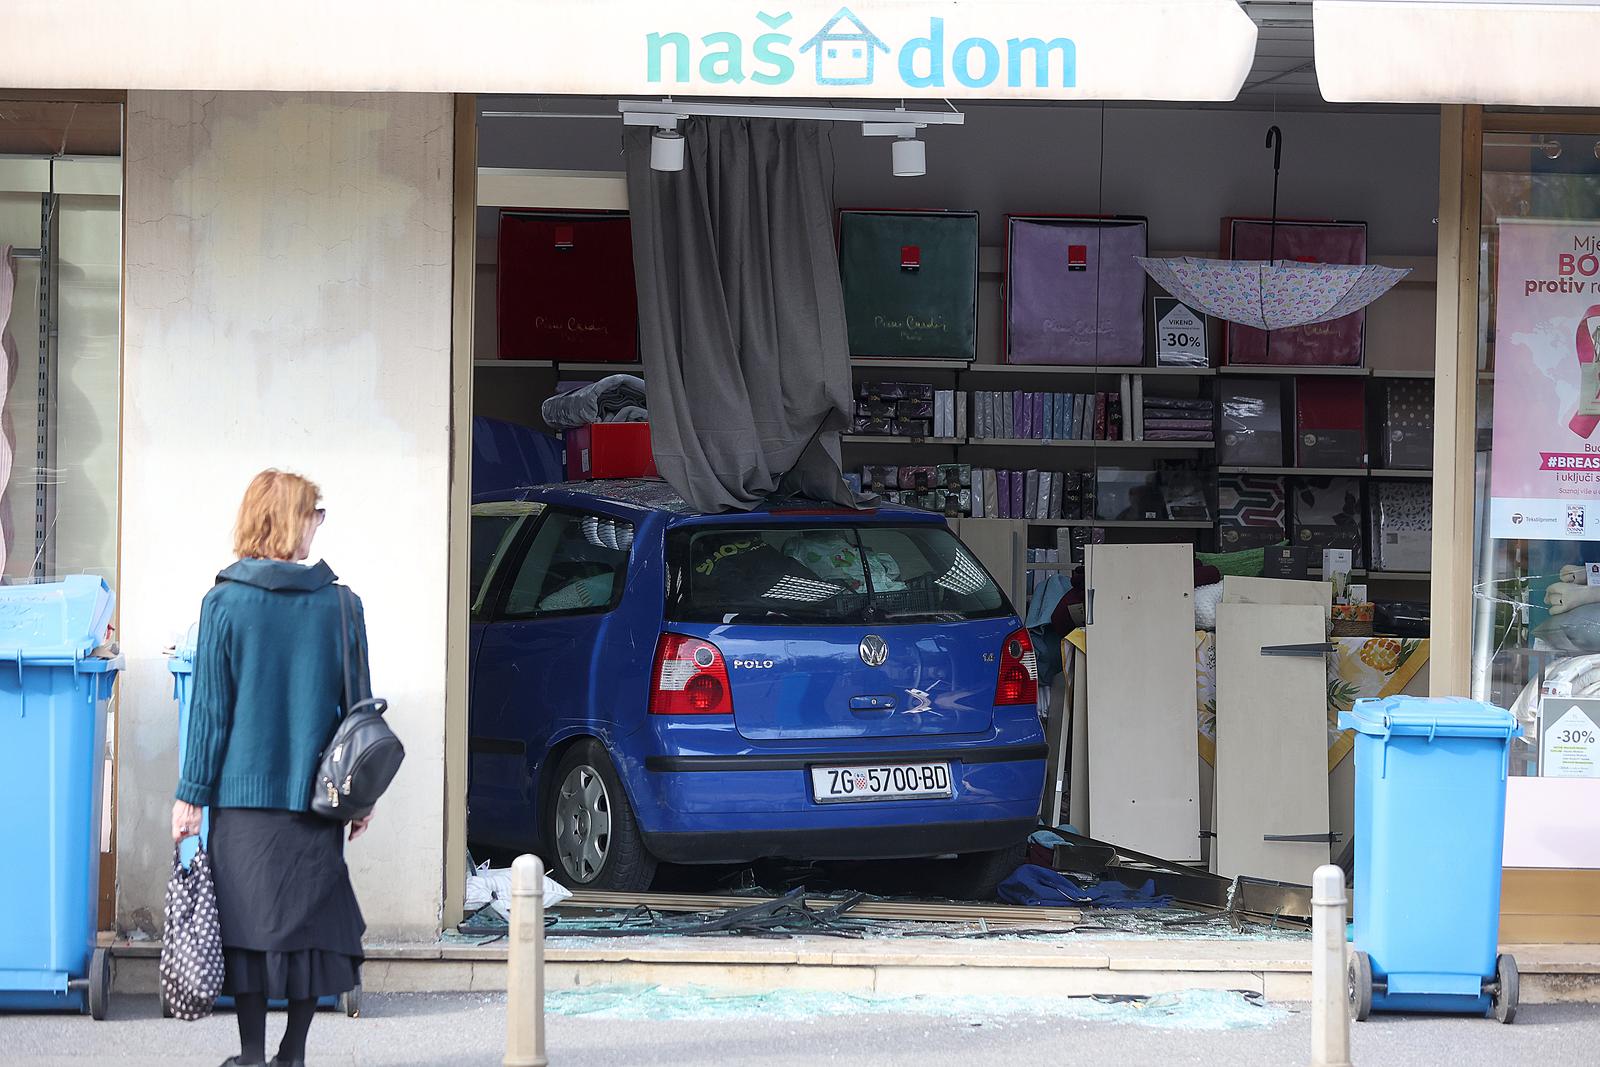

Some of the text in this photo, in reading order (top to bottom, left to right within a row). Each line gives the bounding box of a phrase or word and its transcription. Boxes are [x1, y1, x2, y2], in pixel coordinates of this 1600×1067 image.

[646, 10, 1076, 88] naš dom
[1559, 253, 1599, 276] BO
[1525, 277, 1585, 296] protiv
[1162, 332, 1201, 348] -30%
[1547, 456, 1600, 469] #BREAS
[1561, 472, 1593, 484] uključi
[733, 659, 774, 669] POLO
[1556, 729, 1595, 744] -30%
[827, 769, 855, 795] ZG
